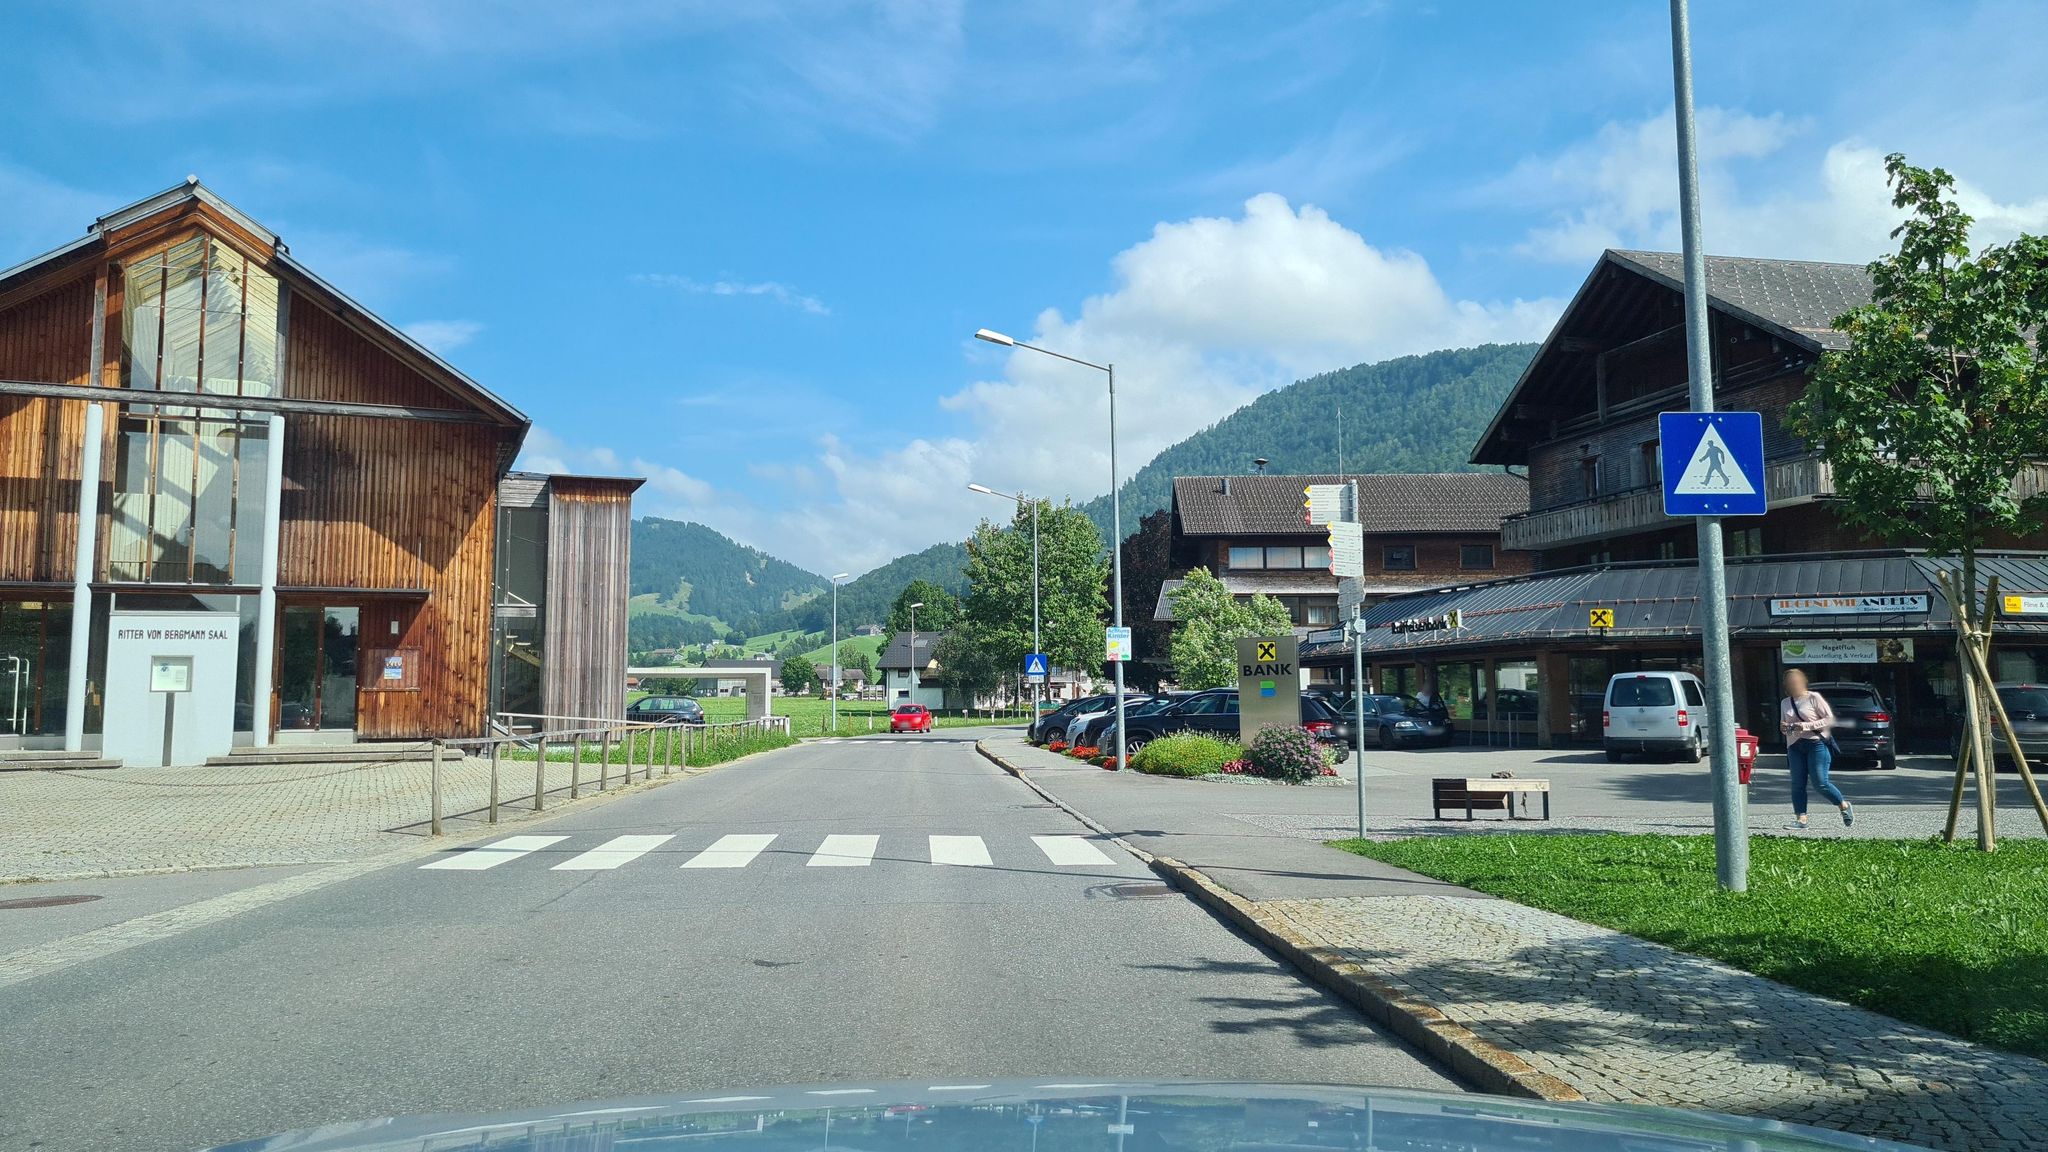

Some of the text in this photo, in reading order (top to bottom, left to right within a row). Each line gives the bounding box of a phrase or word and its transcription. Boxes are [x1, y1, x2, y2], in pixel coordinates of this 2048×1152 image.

[118, 629, 228, 640] RITTER VON BERGMANN SAAL
[1243, 663, 1293, 677] BANK
